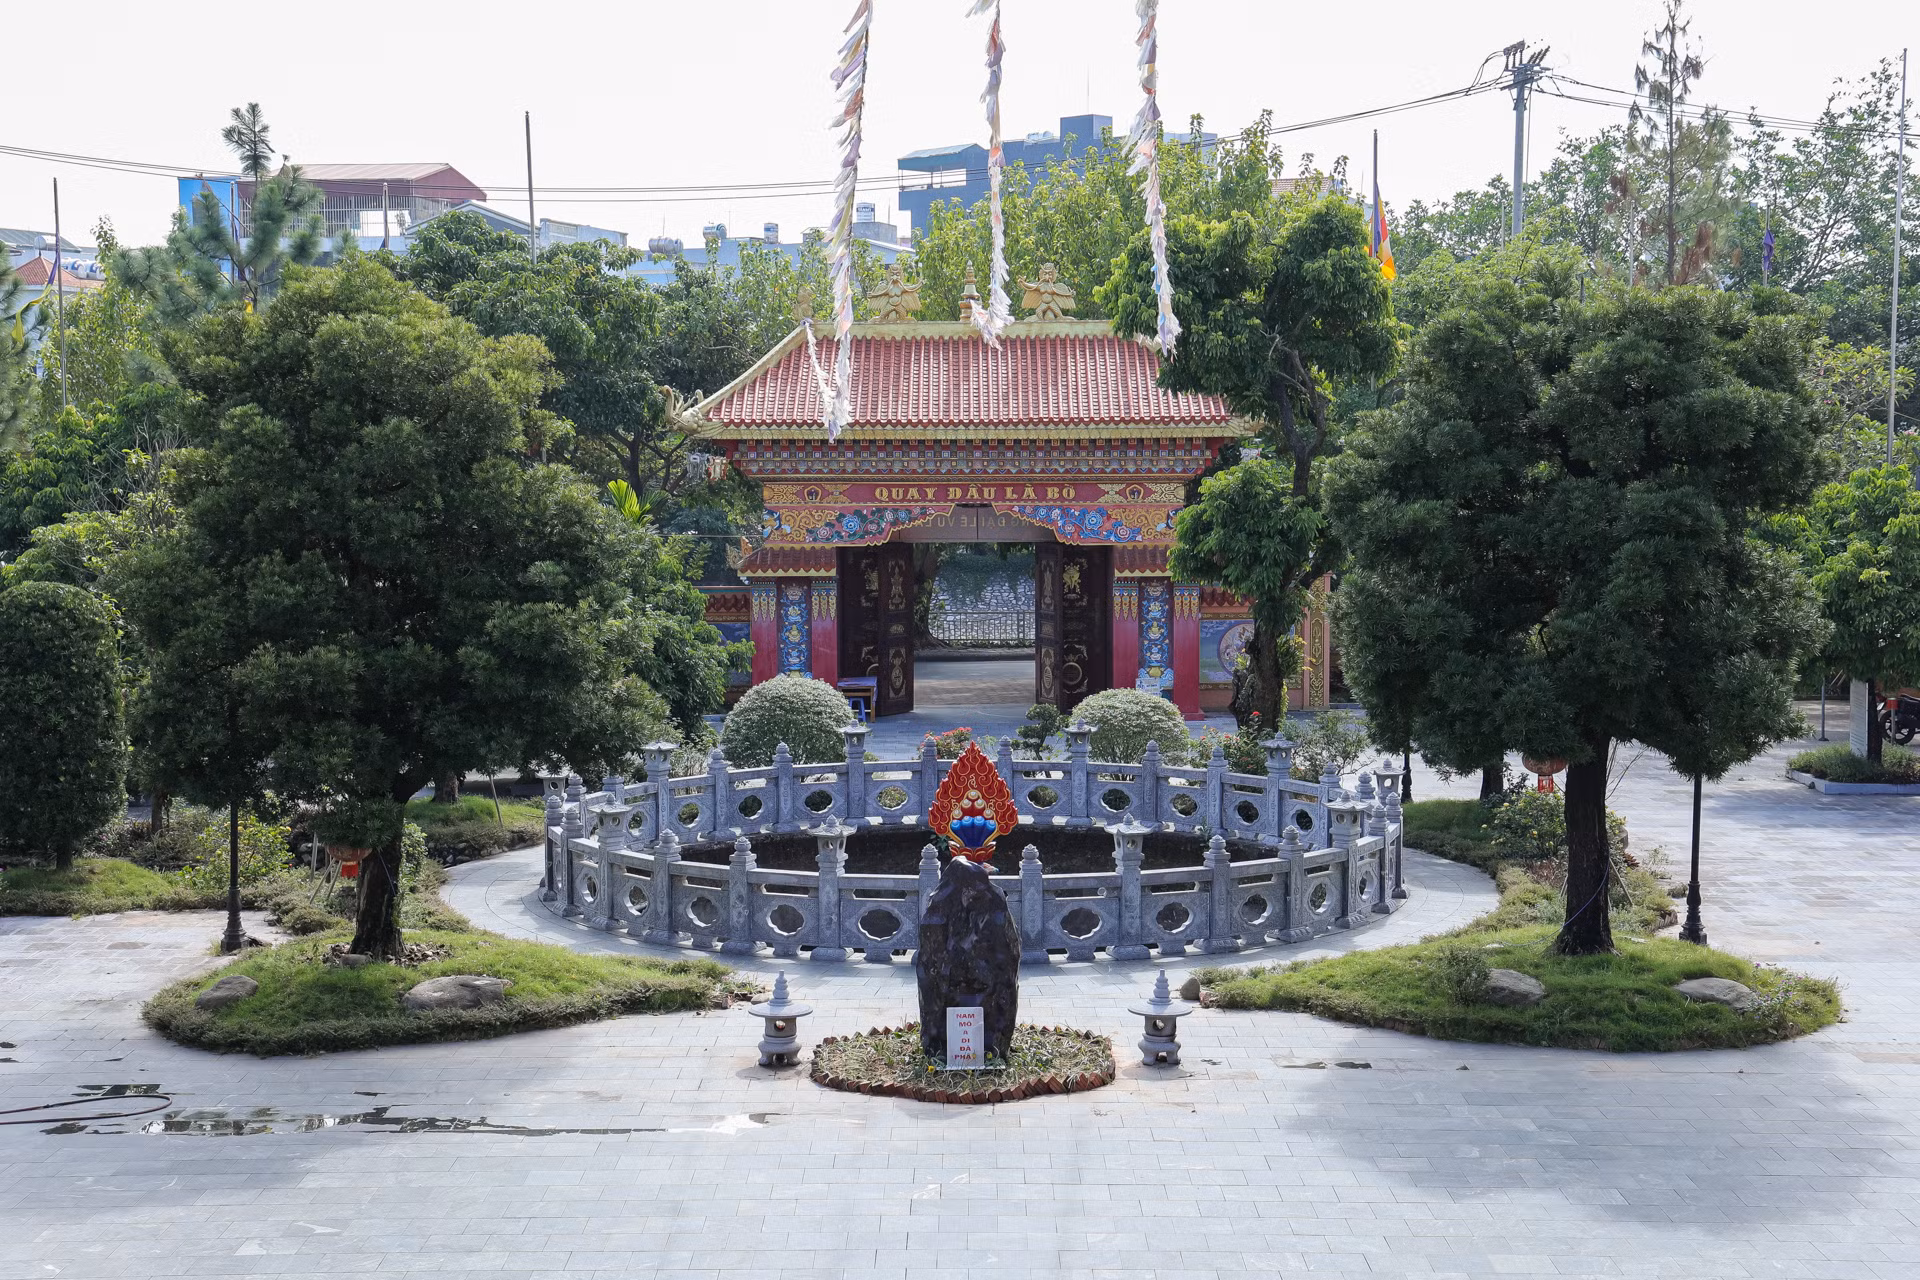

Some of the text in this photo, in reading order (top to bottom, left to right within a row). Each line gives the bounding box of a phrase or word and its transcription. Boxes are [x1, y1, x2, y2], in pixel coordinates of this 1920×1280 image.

[875, 486, 938, 501] QUAY
[947, 484, 996, 500] ĐẦU
[1004, 484, 1038, 499] LÀ
